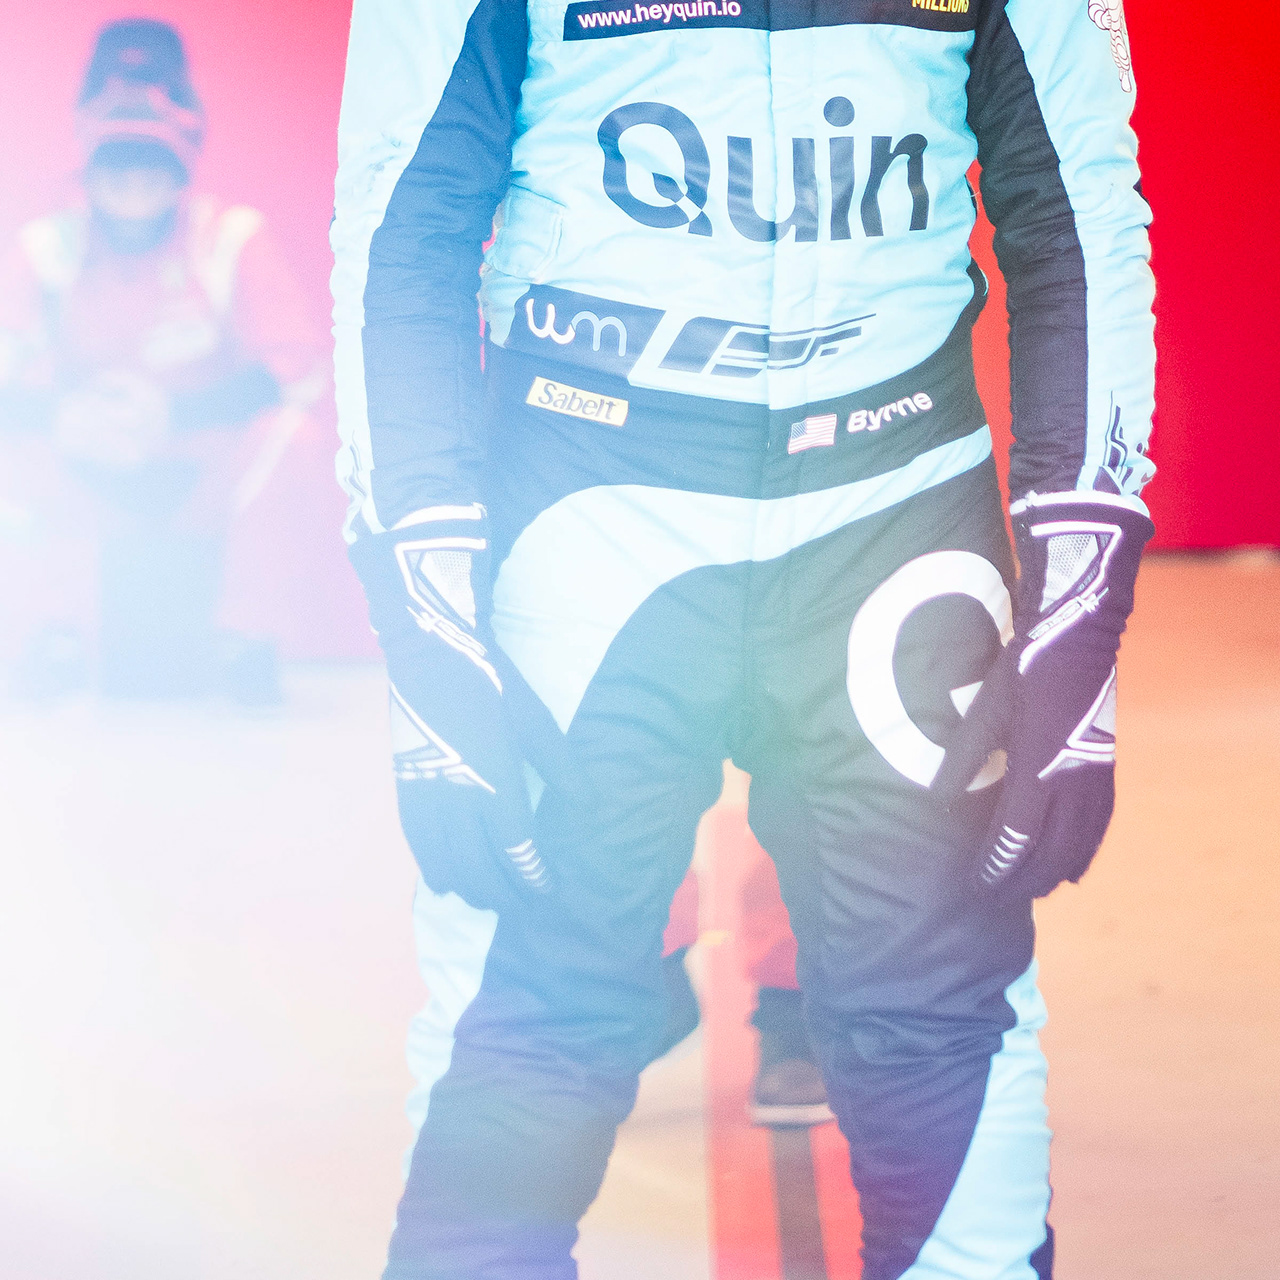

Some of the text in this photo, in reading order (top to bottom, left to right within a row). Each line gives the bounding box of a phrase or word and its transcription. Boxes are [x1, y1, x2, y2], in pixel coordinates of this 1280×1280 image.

[597, 96, 930, 242] Quin
[537, 382, 618, 420] Sabelt
[847, 391, 933, 433] Byrne
